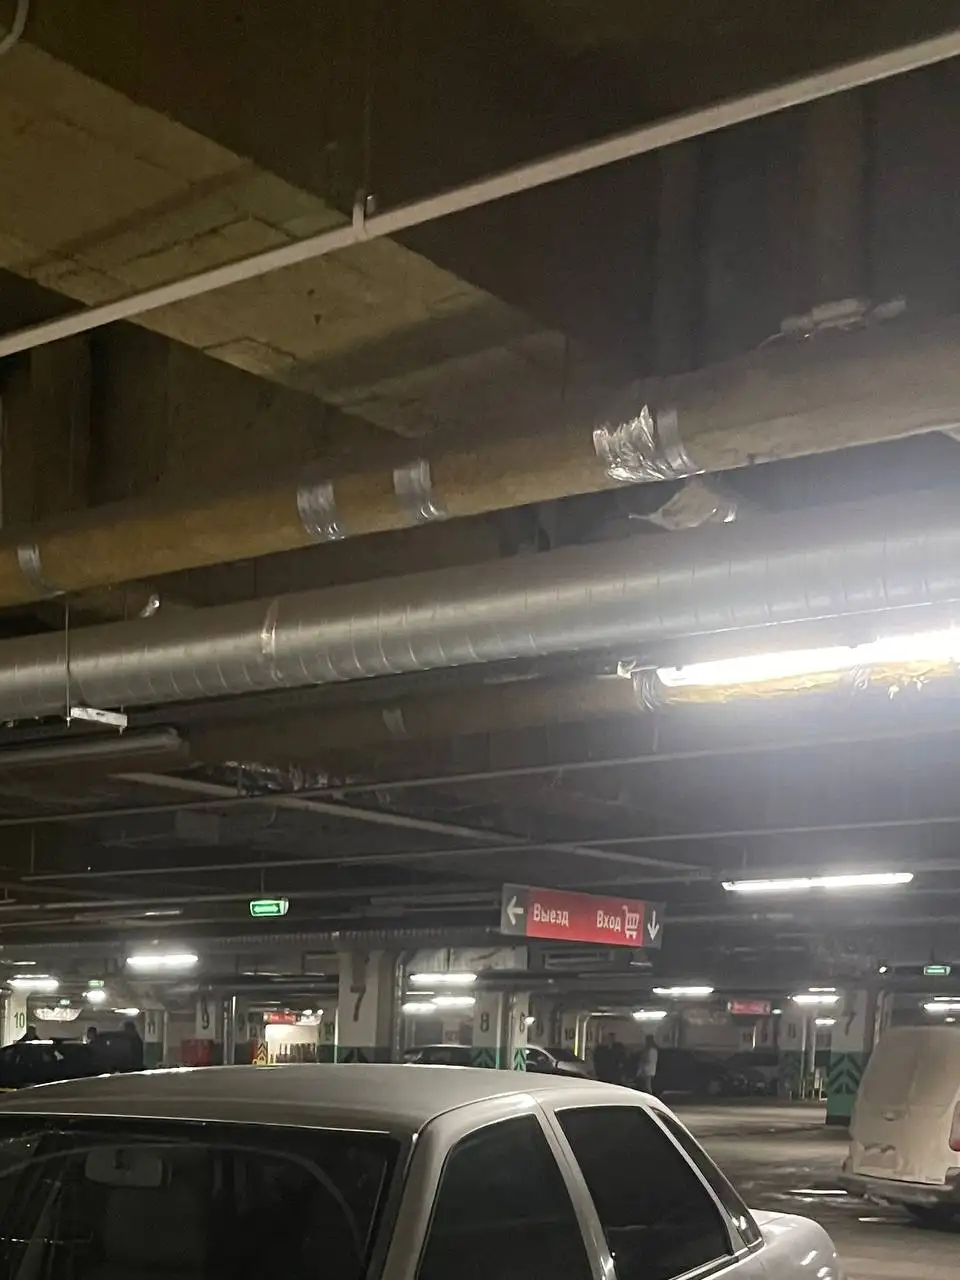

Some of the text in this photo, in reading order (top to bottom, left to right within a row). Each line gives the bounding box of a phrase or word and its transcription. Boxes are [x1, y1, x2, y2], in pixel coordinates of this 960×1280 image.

[533, 903, 622, 933] Выезд Вход
[350, 984, 367, 1022] 7
[13, 1012, 25, 1029] 10
[480, 1012, 489, 1033] 8
